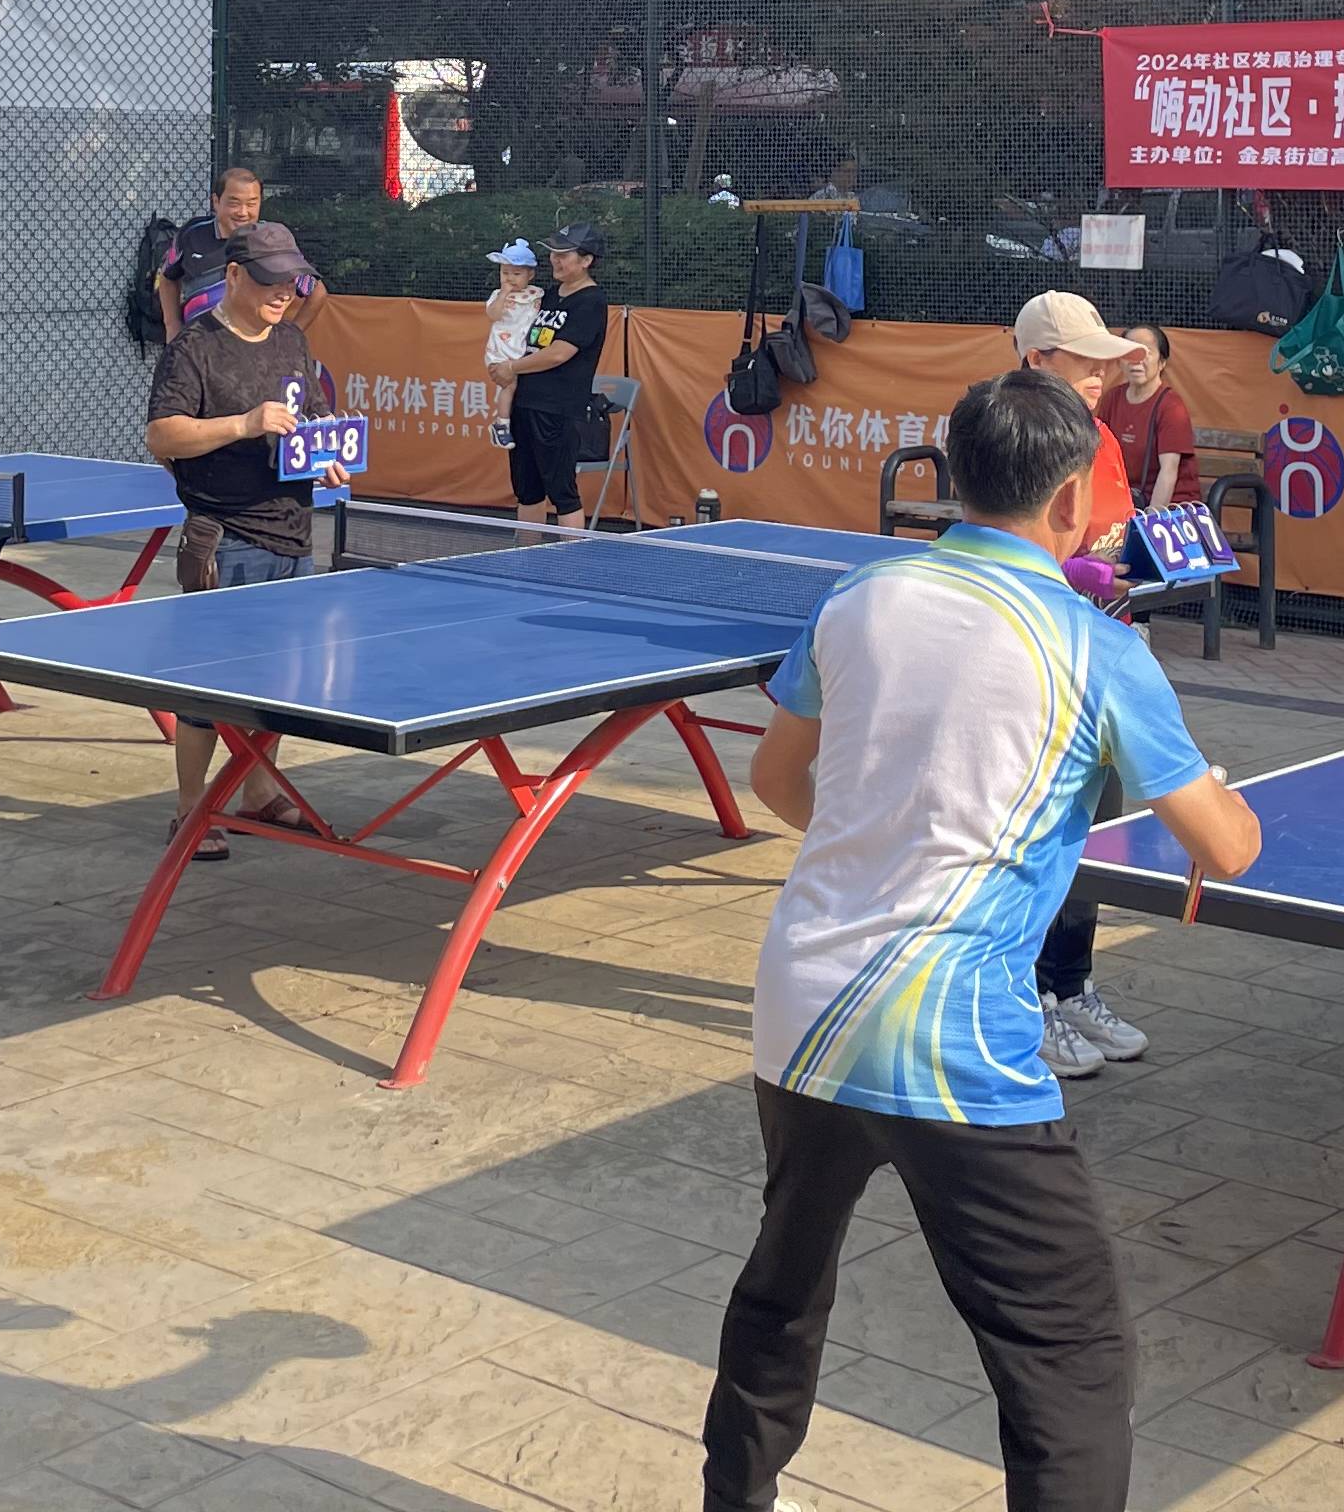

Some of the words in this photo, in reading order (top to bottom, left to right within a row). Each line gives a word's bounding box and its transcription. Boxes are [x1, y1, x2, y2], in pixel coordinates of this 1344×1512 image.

[345, 373, 503, 419] 优你体育俱
[418, 421, 485, 437] SPORT
[786, 452, 862, 473] YOUNI
